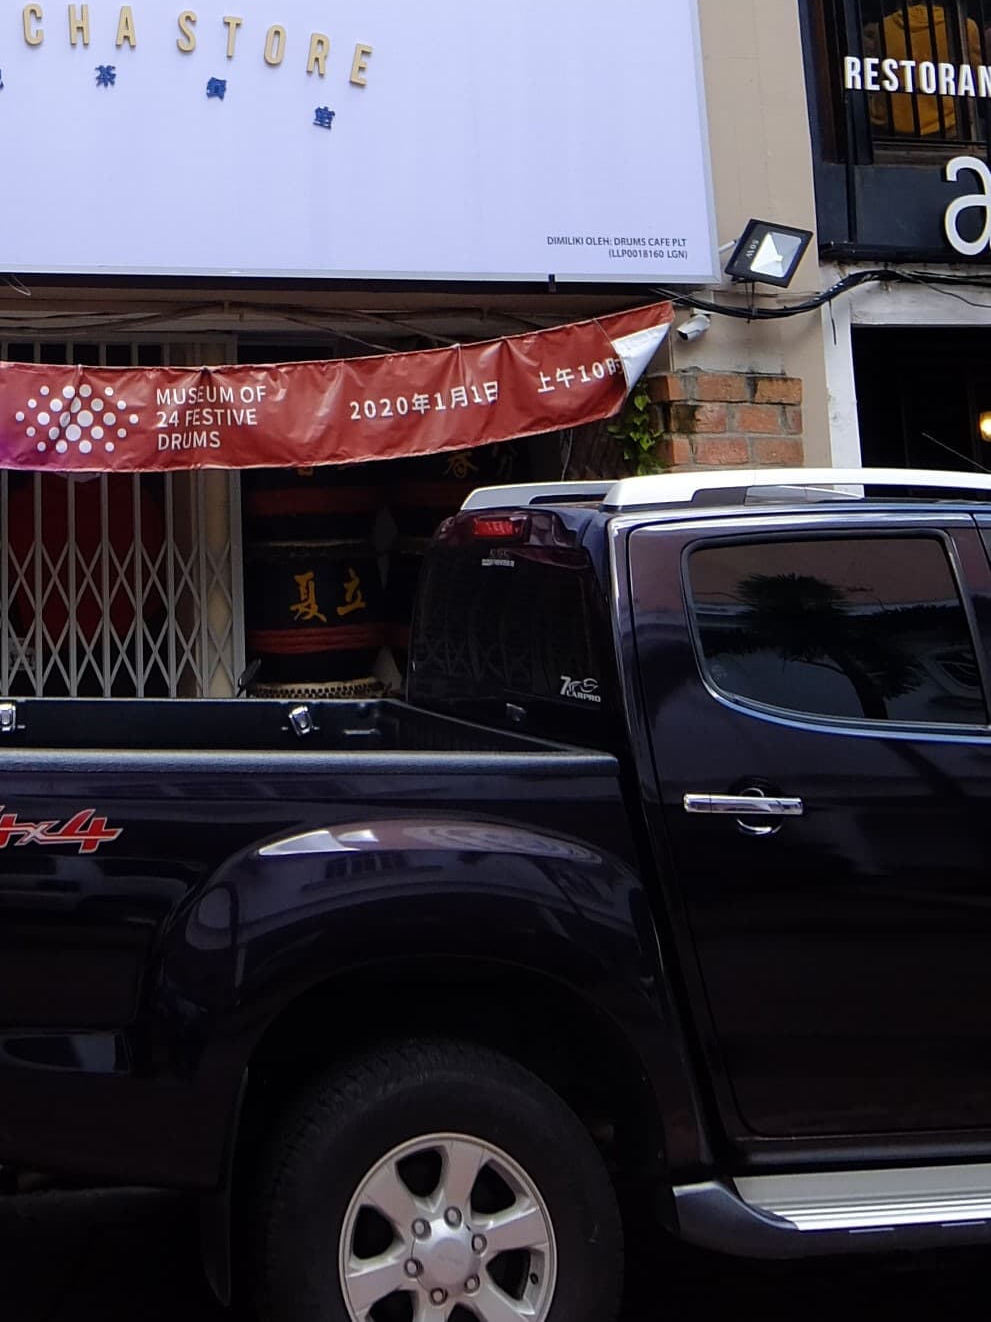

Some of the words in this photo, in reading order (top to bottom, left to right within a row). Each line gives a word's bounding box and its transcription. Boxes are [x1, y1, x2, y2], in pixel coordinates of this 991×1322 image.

[22, 3, 136, 48] CHA
[176, 10, 374, 87] STORE
[844, 56, 991, 98] RESTORAN
[547, 236, 584, 246] DIMILIKI
[613, 237, 646, 247] DRUMS
[647, 238, 670, 247] CAFE
[672, 238, 687, 247] PLT
[156, 385, 235, 406] MUSEUM
[239, 385, 267, 403] OF
[349, 380, 499, 420] 2020年1月1日
[156, 410, 180, 428] 24
[184, 408, 258, 428] FESTIVE
[157, 430, 221, 451] DRUMS
